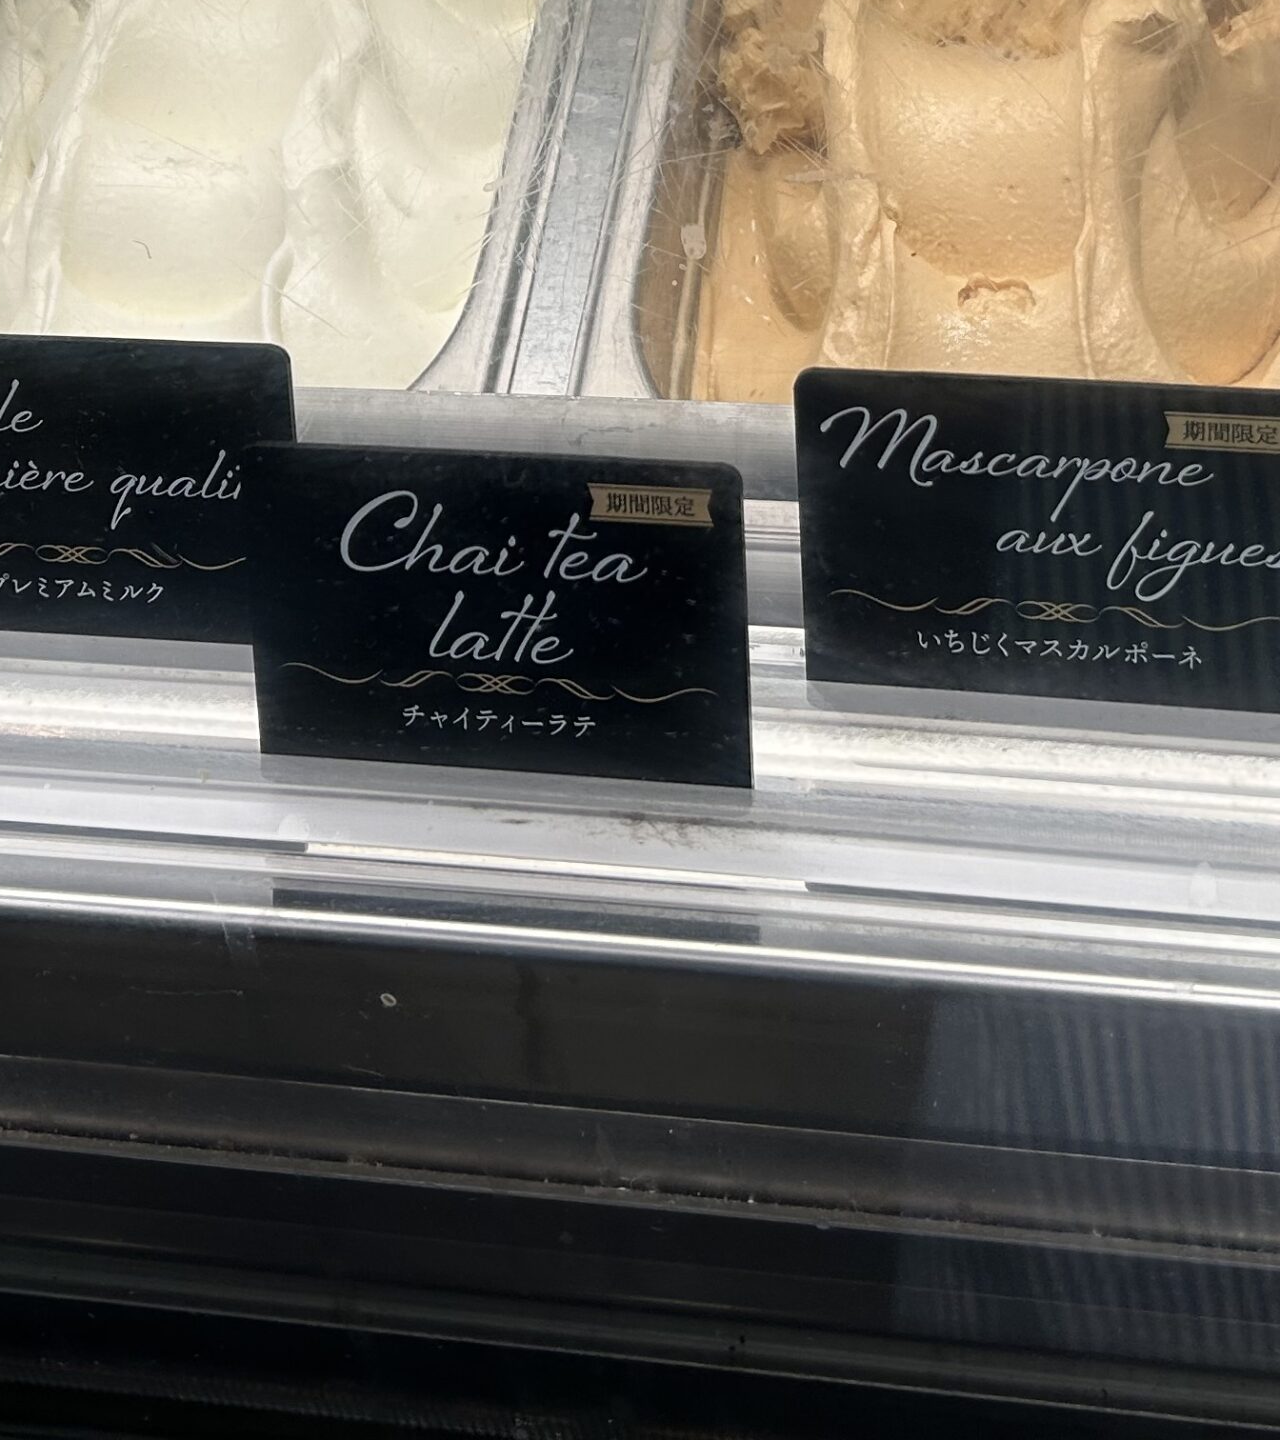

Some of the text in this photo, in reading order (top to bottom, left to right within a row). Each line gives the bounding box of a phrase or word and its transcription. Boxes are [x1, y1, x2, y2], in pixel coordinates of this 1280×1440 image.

[1183, 420, 1279, 445] 期間限定
[820, 406, 1214, 522] Mascarpone
[606, 492, 696, 517] 期間限定
[340, 490, 648, 582] Chai tea
[995, 528, 1103, 556] aux
[429, 590, 574, 664] latte
[917, 628, 1203, 670] いちじくマスカルポーネ
[402, 704, 597, 738] チャイティーラテ
